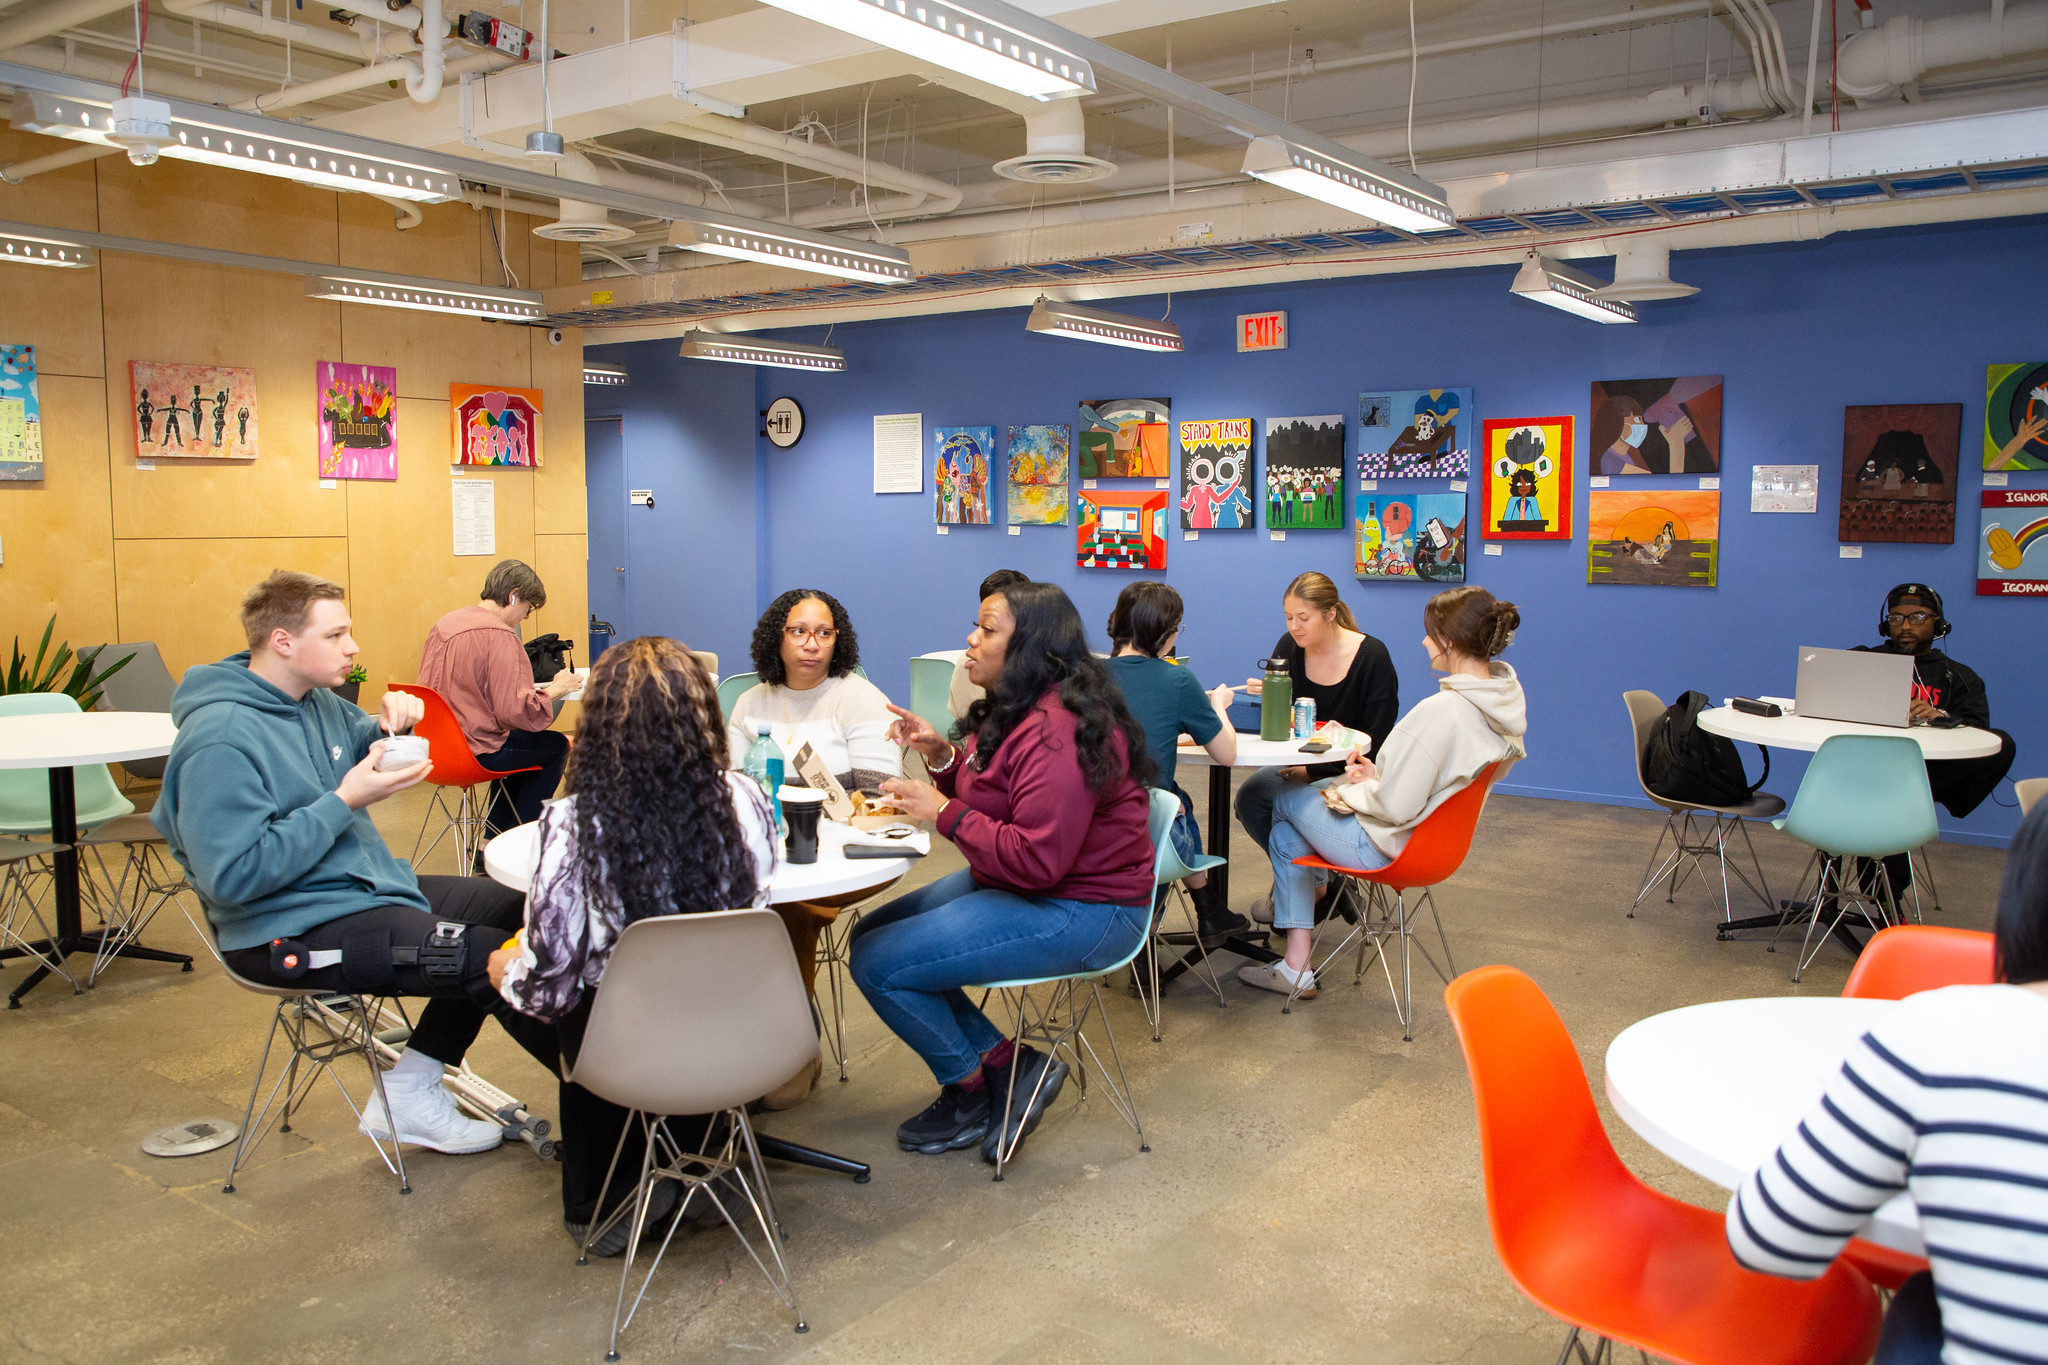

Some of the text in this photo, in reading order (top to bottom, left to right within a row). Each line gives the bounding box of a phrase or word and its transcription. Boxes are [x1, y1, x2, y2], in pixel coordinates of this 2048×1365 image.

[1245, 316, 1279, 348] EXIT
[1181, 423, 1212, 441] STAND
[1217, 420, 1249, 440] TRANS
